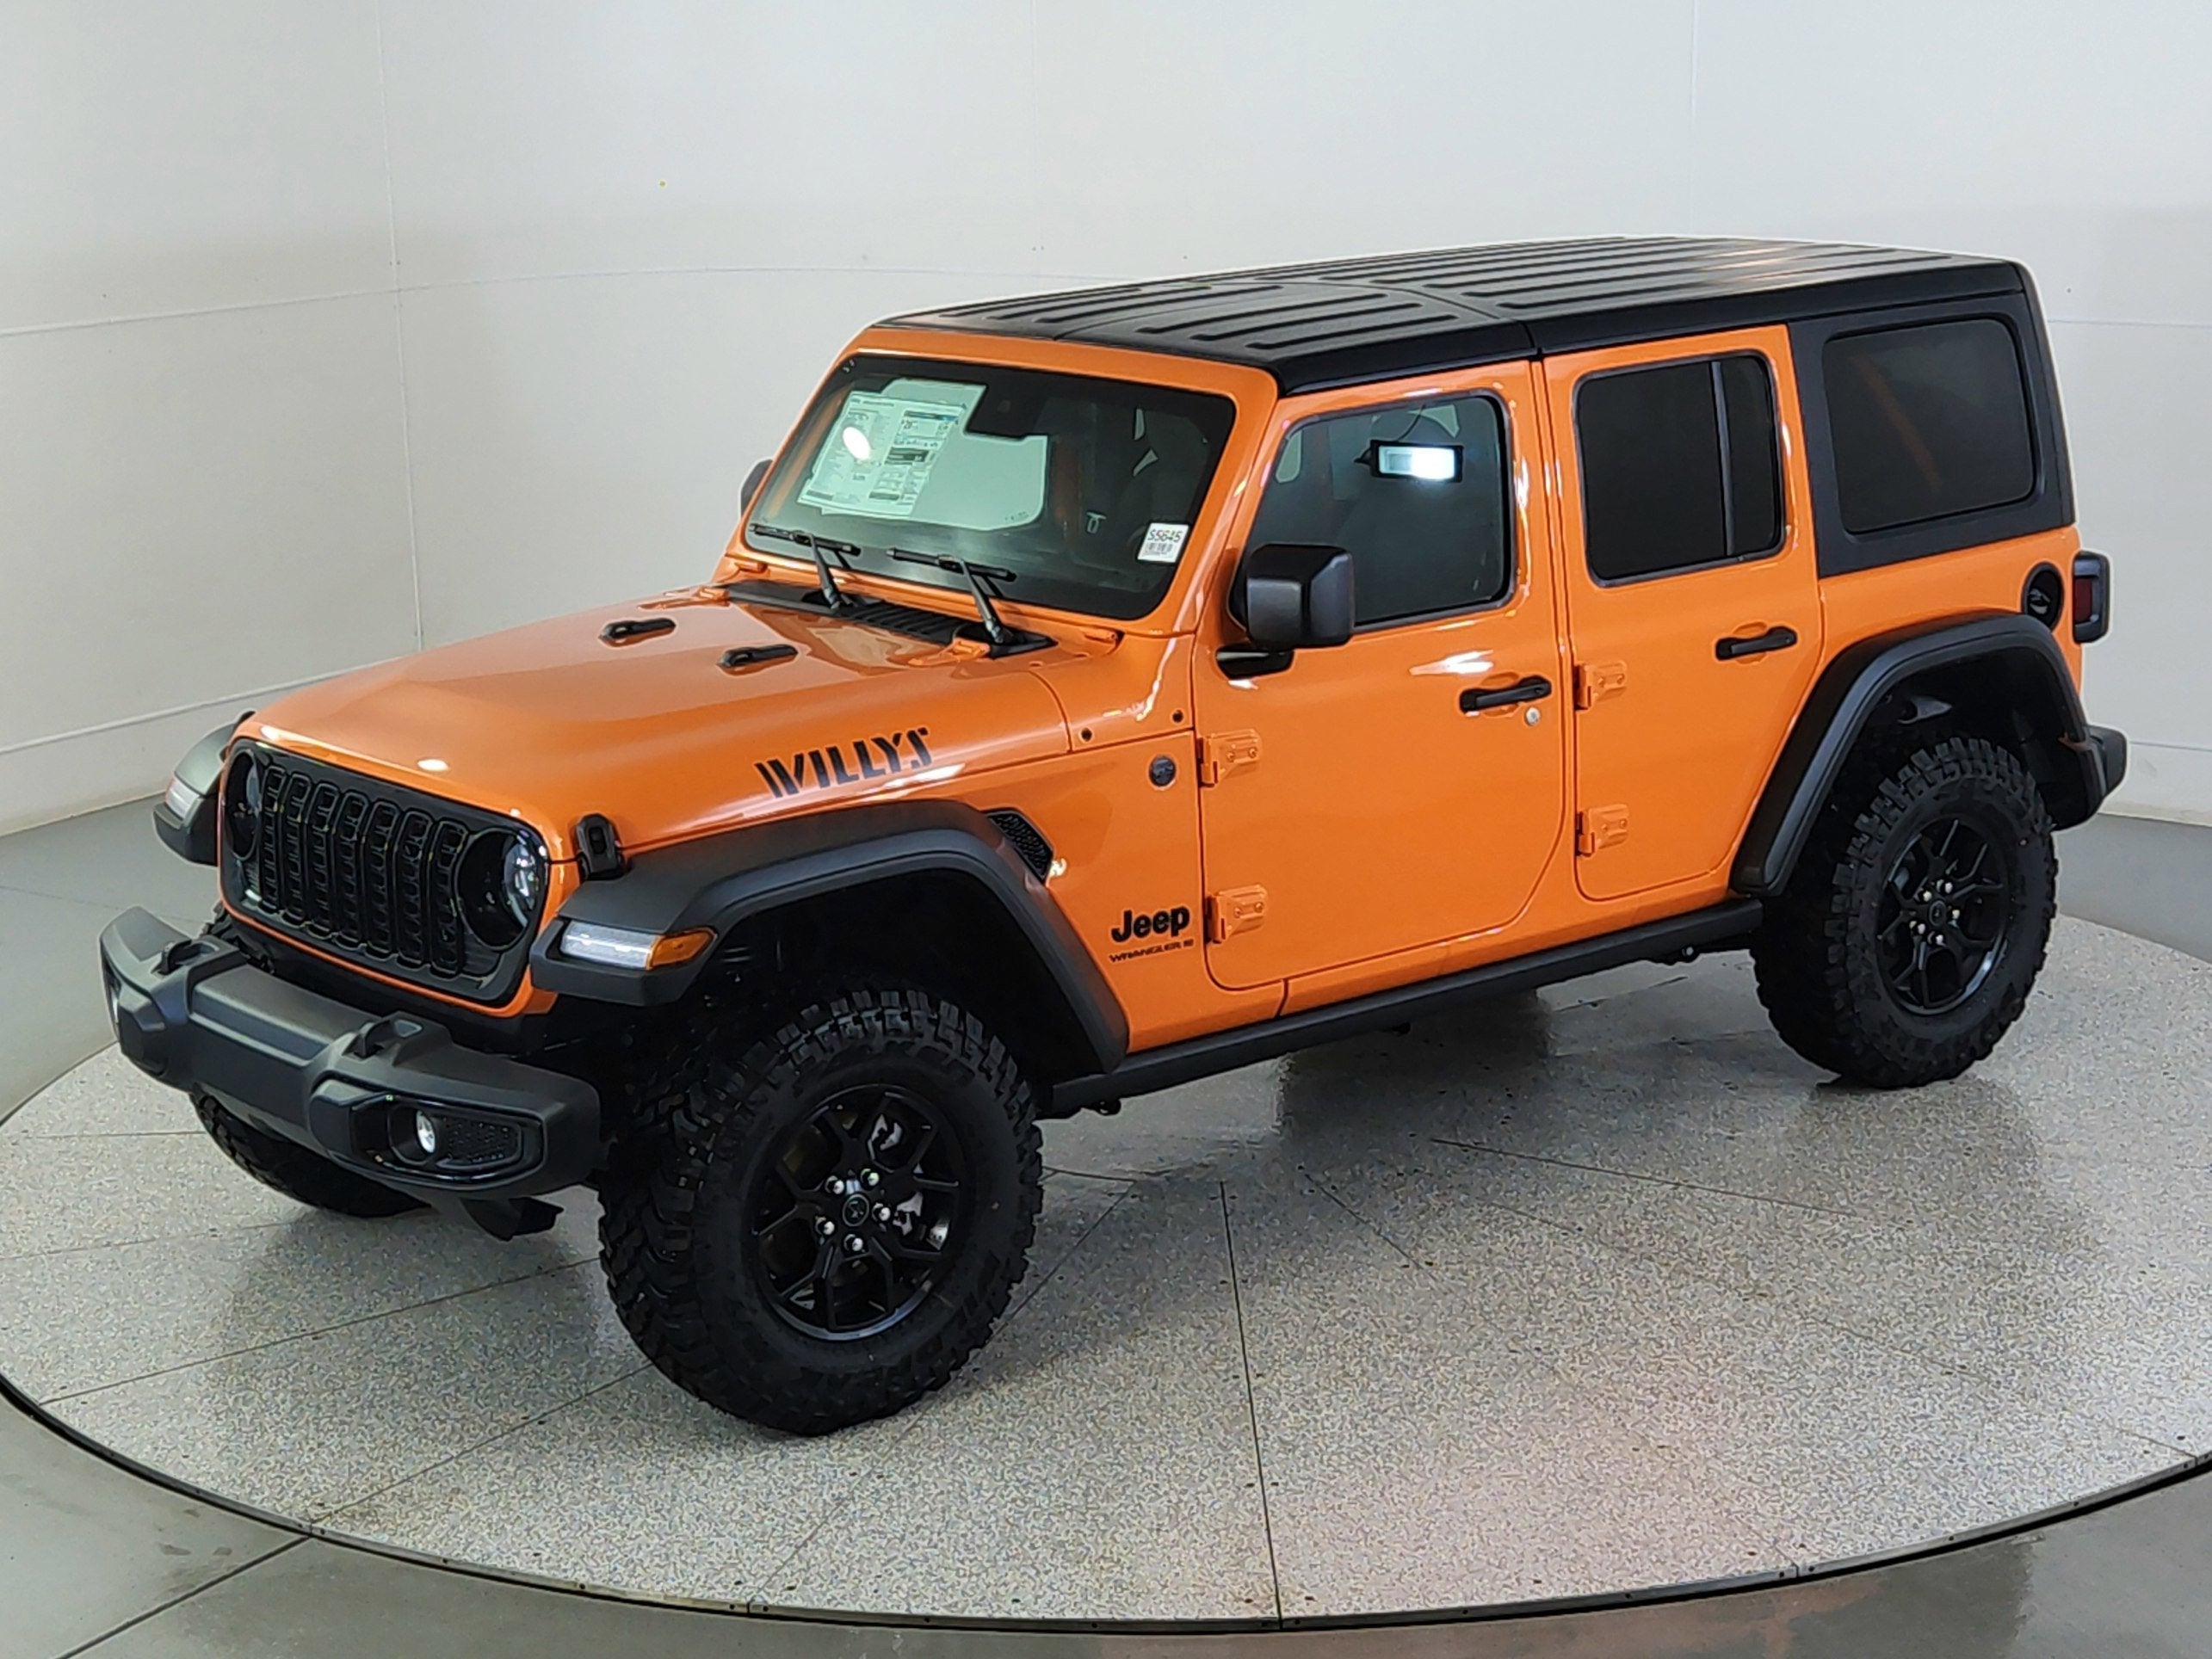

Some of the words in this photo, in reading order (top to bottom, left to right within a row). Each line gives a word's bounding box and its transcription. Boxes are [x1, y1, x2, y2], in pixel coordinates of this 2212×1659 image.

[755, 727, 931, 798] WILLYS
[1111, 906, 1189, 943] Jeep
[1109, 942, 1182, 962] WRANGLER
